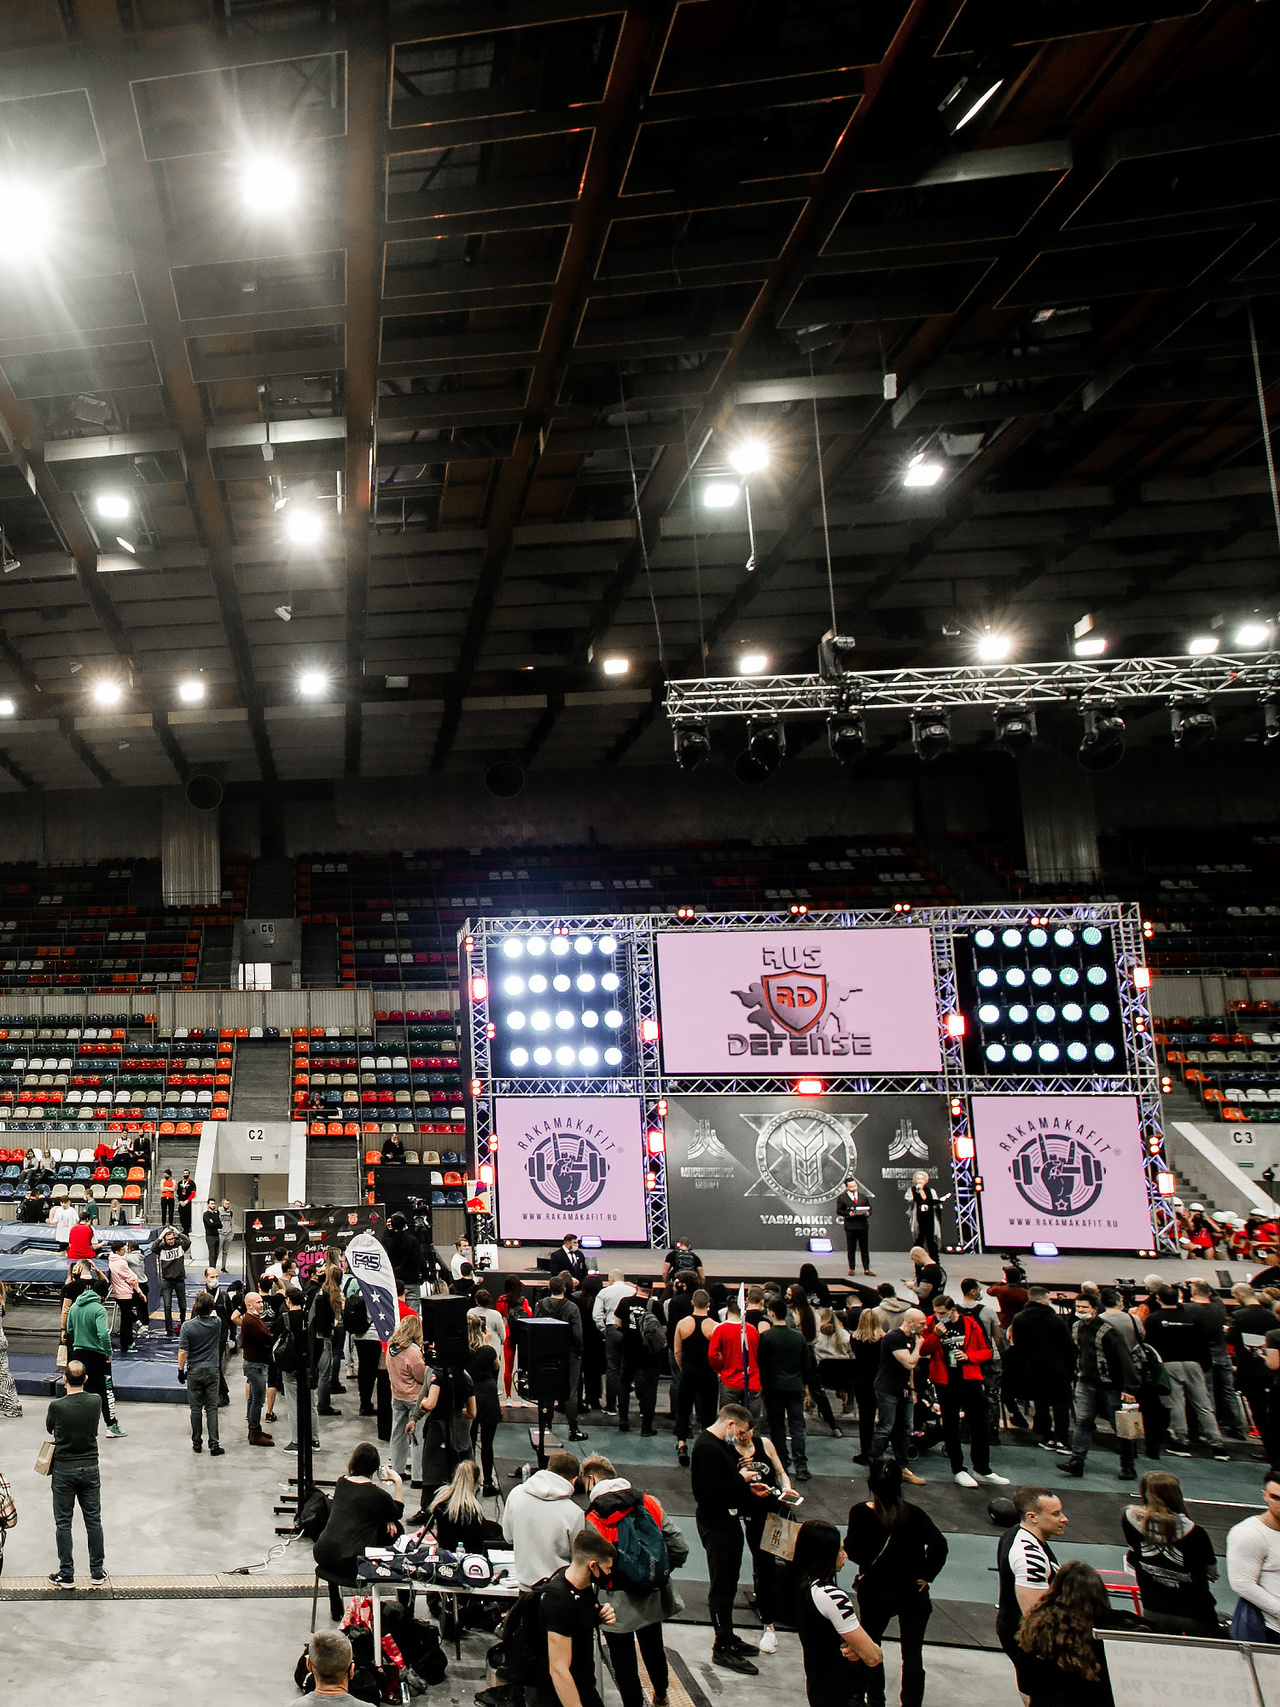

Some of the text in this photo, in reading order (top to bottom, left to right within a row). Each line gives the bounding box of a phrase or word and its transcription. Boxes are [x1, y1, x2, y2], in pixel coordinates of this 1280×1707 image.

[261, 924, 273, 932] C6
[762, 946, 822, 969] RUS
[776, 986, 817, 1008] RD
[728, 1033, 871, 1055] DEFENSE
[249, 1130, 263, 1139] C2
[517, 1117, 615, 1150] RAKAMAKAFIT
[999, 1117, 1111, 1152] RAKAMAKAFIT
[1234, 1132, 1252, 1143] C3
[522, 1213, 617, 1221] WWW.RAKAMAKAFIT.RU
[760, 1215, 834, 1225] YASHANKIN
[1009, 1218, 1118, 1228] WWW.RAKAMAKAFIT.RU
[795, 1228, 827, 1237] 2020
[353, 1251, 381, 1271] F45
[1021, 1539, 1046, 1582] WIN
